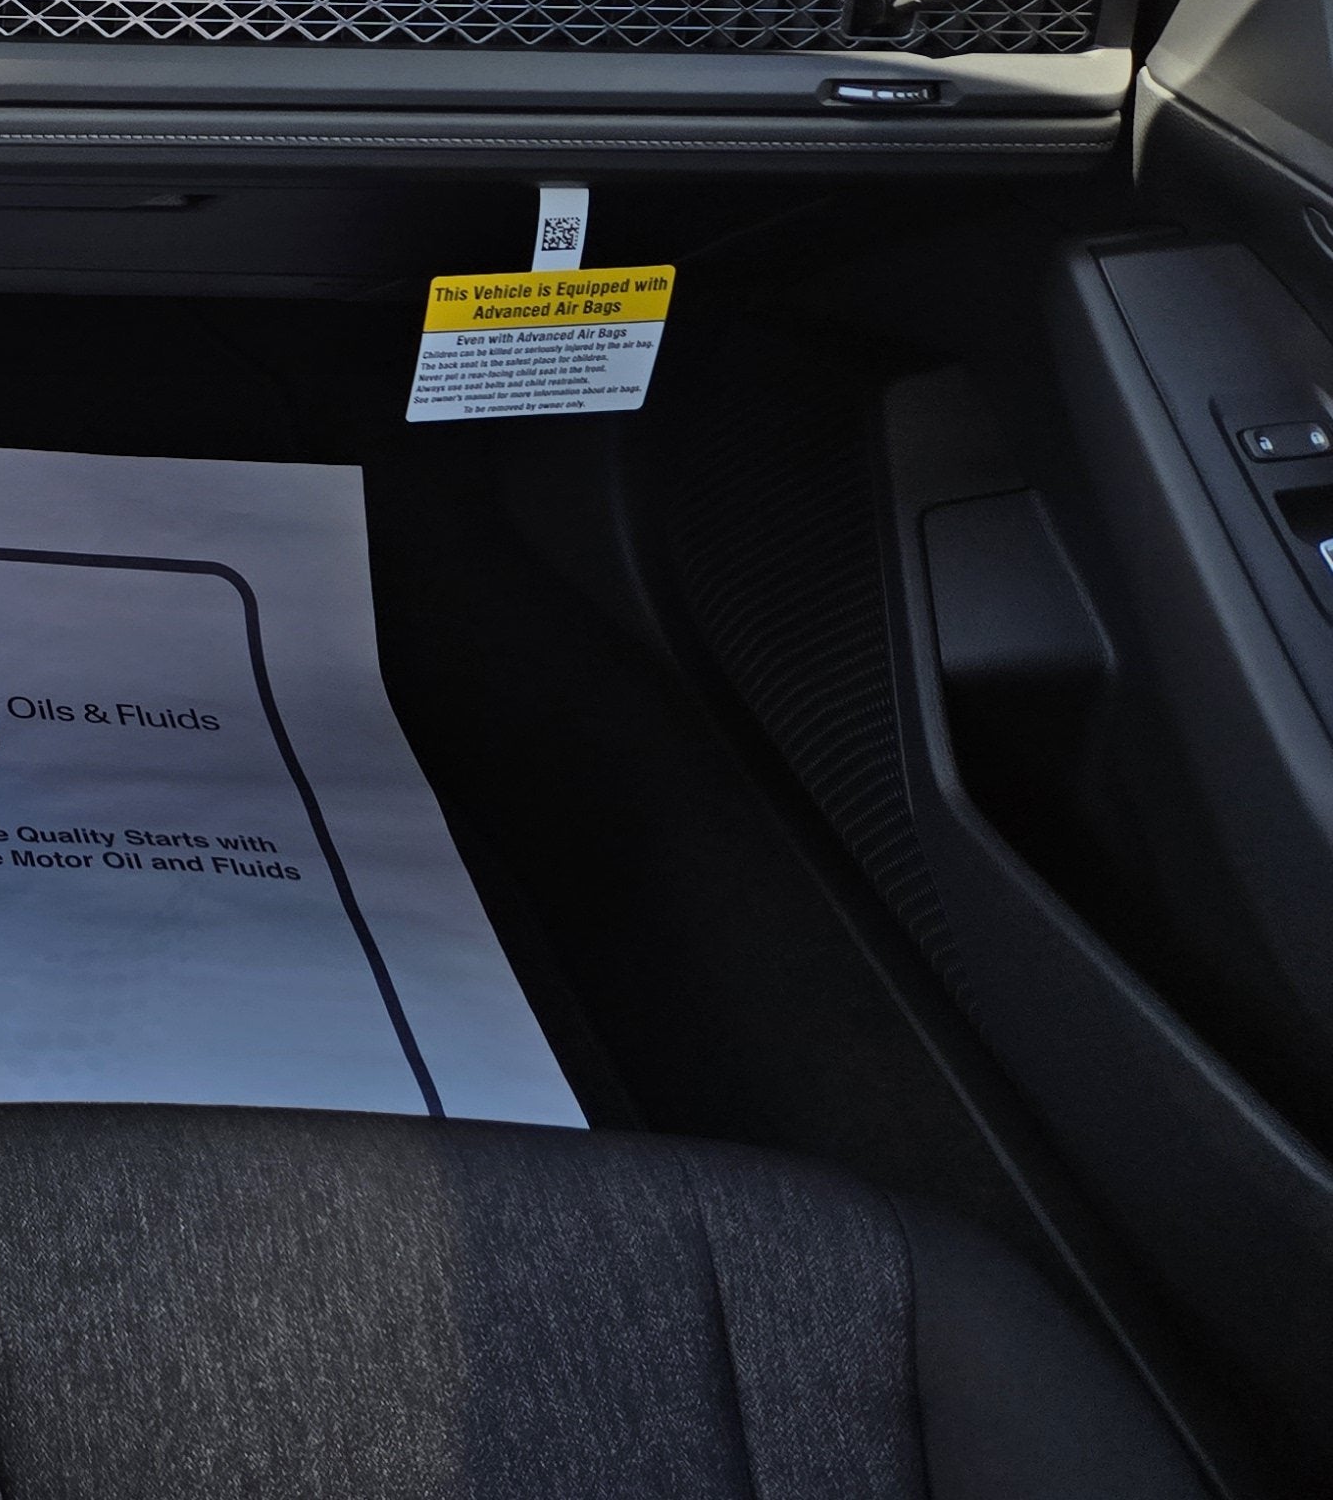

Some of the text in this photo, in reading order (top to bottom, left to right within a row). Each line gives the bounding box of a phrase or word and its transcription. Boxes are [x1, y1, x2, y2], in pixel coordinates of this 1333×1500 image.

[435, 277, 668, 301] This Vehicle is Equipped with
[473, 300, 622, 320] Advanced Air Bags
[456, 328, 627, 346] Even with Advanced Air Bags
[423, 350, 458, 359] Children
[459, 350, 474, 358] can
[6, 695, 76, 723] Oils
[83, 701, 112, 724] &
[117, 703, 221, 732] Fluids
[16, 825, 115, 848] Quality
[124, 829, 209, 849] Starts
[215, 833, 278, 853] with
[11, 849, 93, 868] Motor
[102, 851, 143, 870] Oil
[151, 855, 205, 872] and
[211, 856, 302, 881] Fluids
